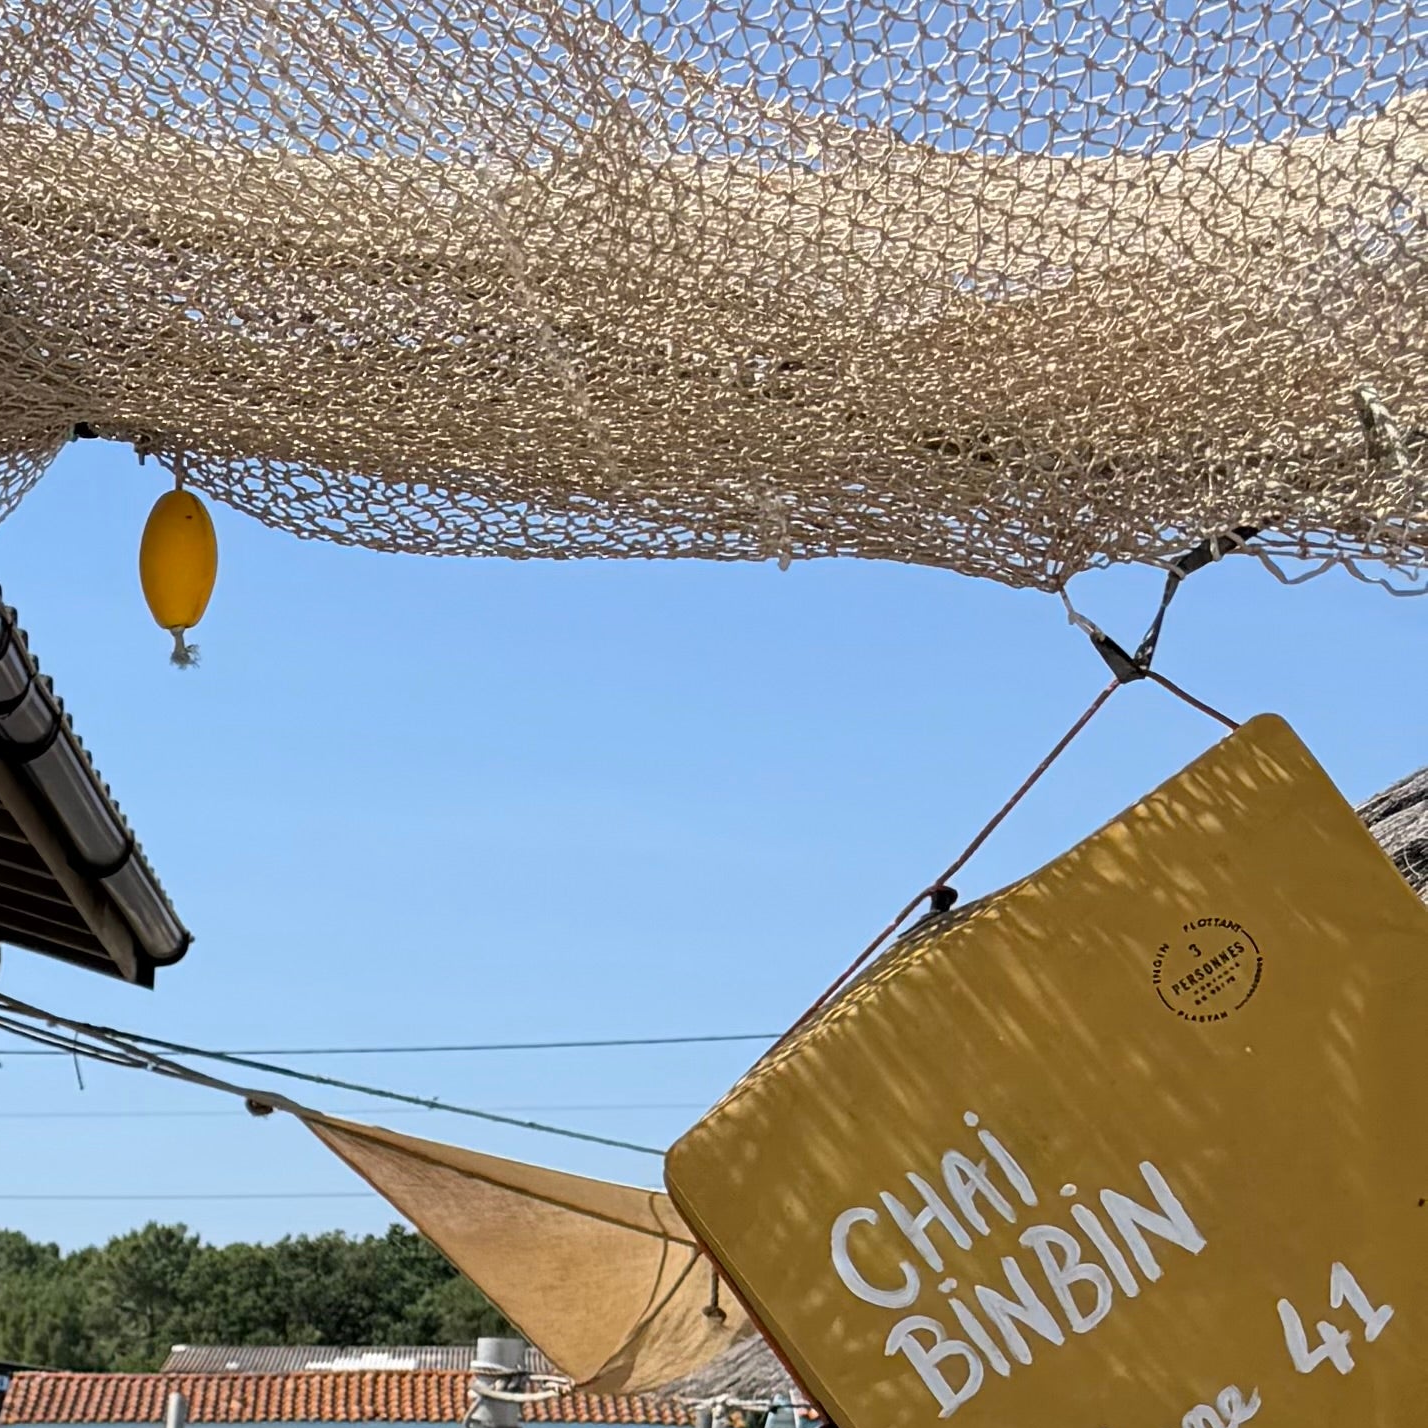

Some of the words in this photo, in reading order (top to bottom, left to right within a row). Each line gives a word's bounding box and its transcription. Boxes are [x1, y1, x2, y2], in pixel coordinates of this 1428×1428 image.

[1171, 941, 1245, 996] PERSONNES
[1188, 943, 1202, 957] 3
[1276, 1262, 1395, 1375] 41
